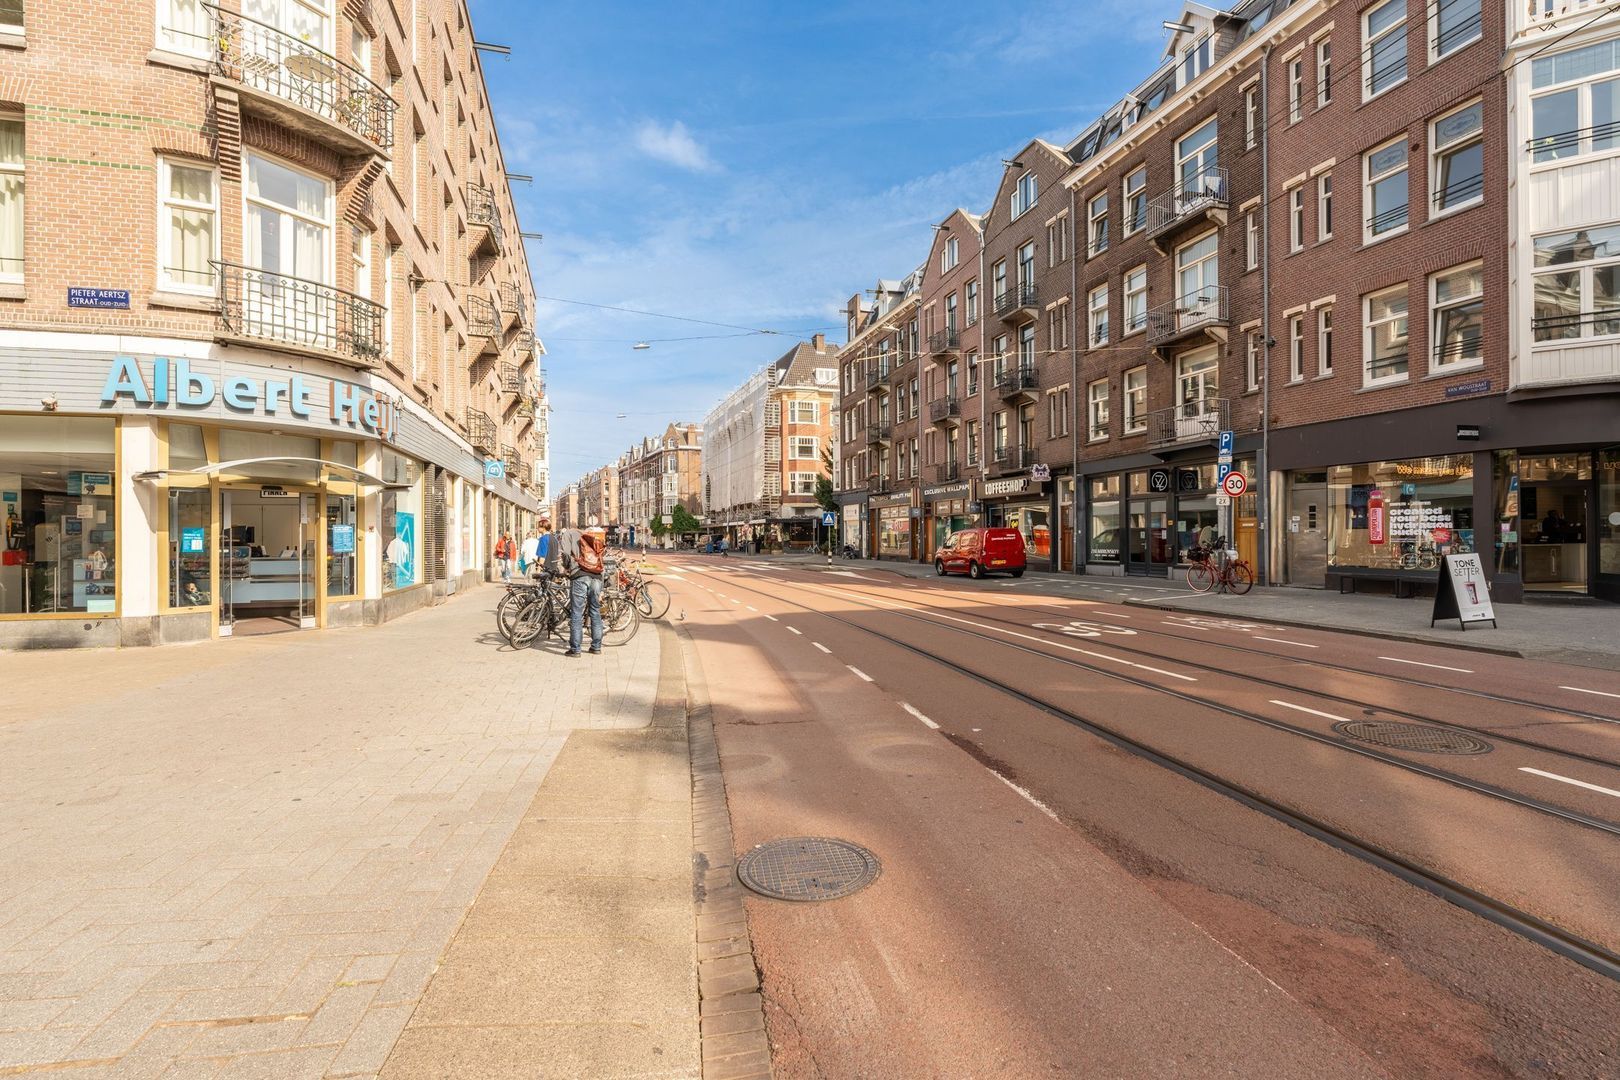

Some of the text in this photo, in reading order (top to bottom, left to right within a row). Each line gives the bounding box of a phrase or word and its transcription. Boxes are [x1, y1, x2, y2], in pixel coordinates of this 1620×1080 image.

[71, 289, 126, 299] PIETER AERTSZ
[71, 297, 98, 305] STRAAT
[99, 355, 314, 418] Albert
[1222, 433, 1230, 446] P
[1220, 465, 1228, 478] P
[1228, 480, 1243, 489] 30
[1389, 507, 1443, 515] created
[1389, 515, 1419, 523] your
[1454, 559, 1476, 568] TONE
[1454, 567, 1480, 576] SETTER
